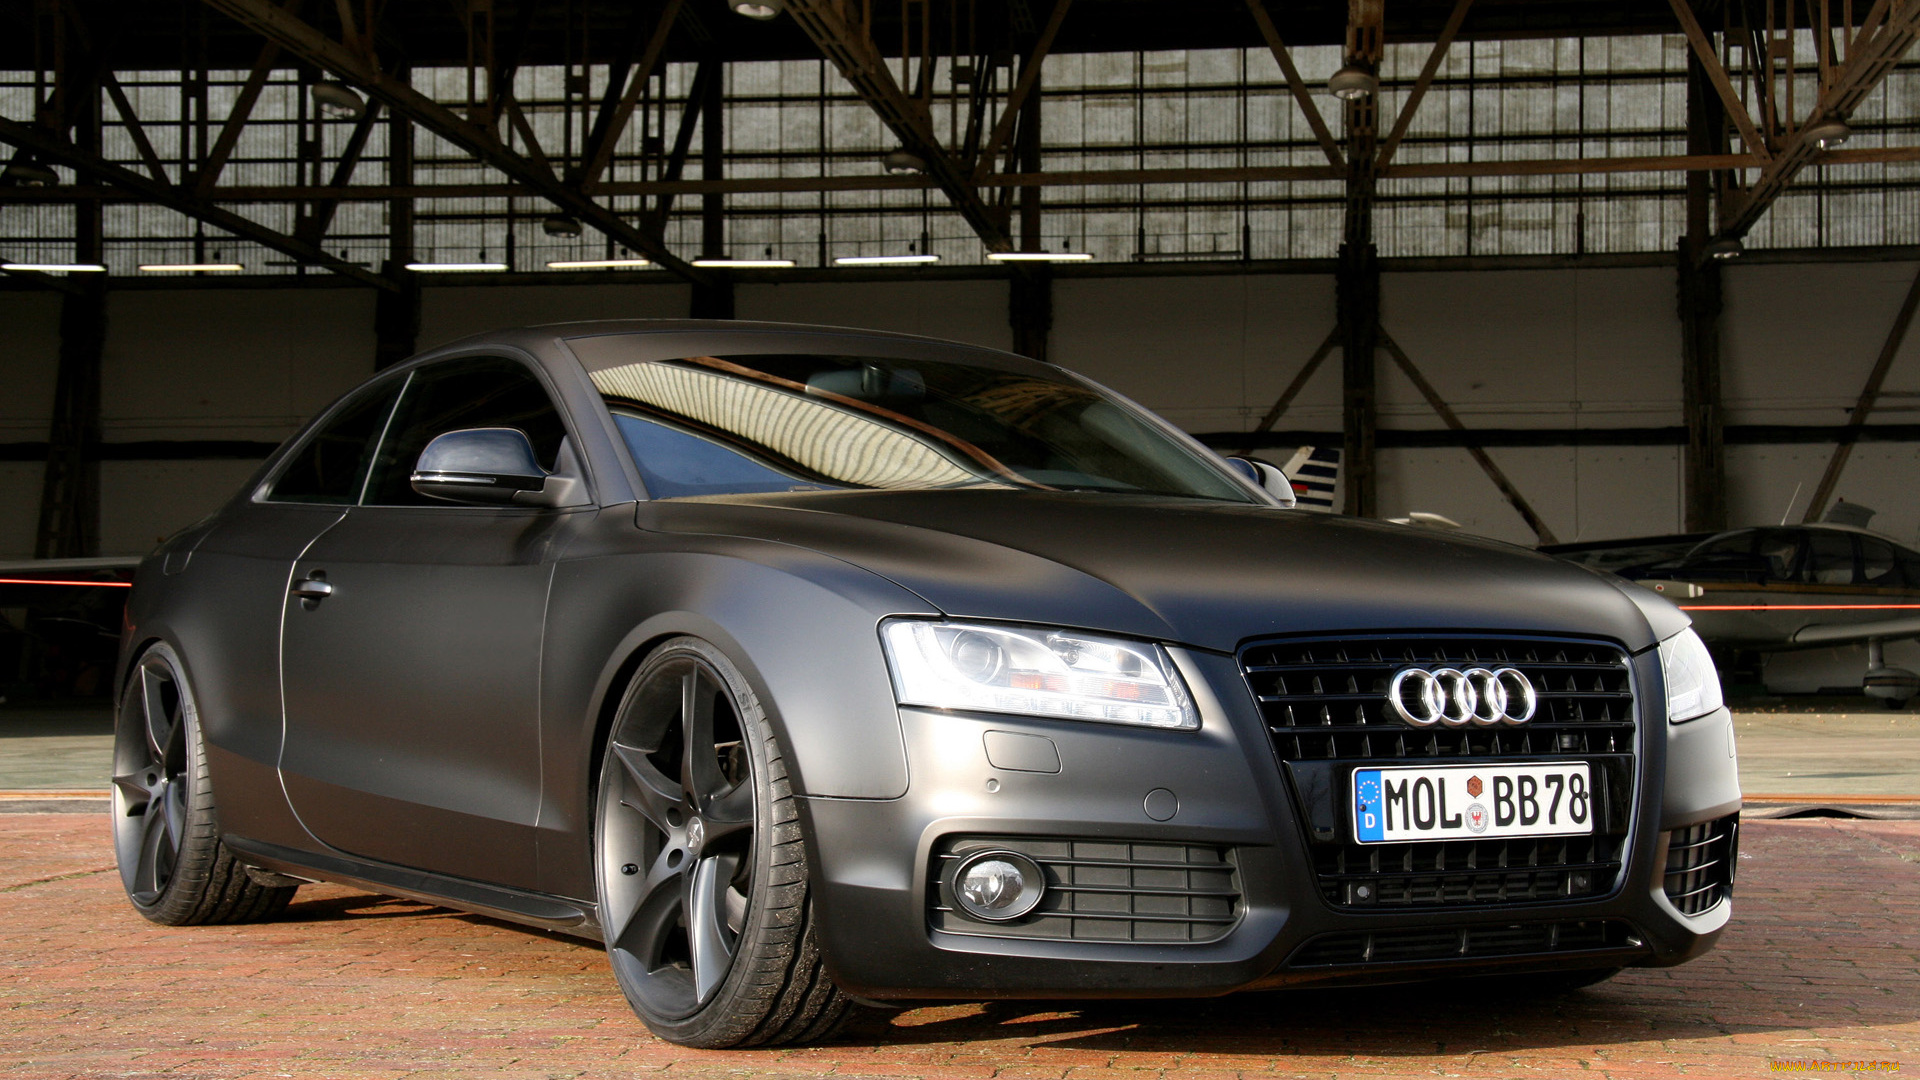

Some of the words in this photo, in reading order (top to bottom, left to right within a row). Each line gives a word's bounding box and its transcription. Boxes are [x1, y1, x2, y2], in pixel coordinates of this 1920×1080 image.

[1384, 776, 1463, 831] MOL
[1493, 773, 1588, 828] BB78
[1365, 813, 1376, 829] D
